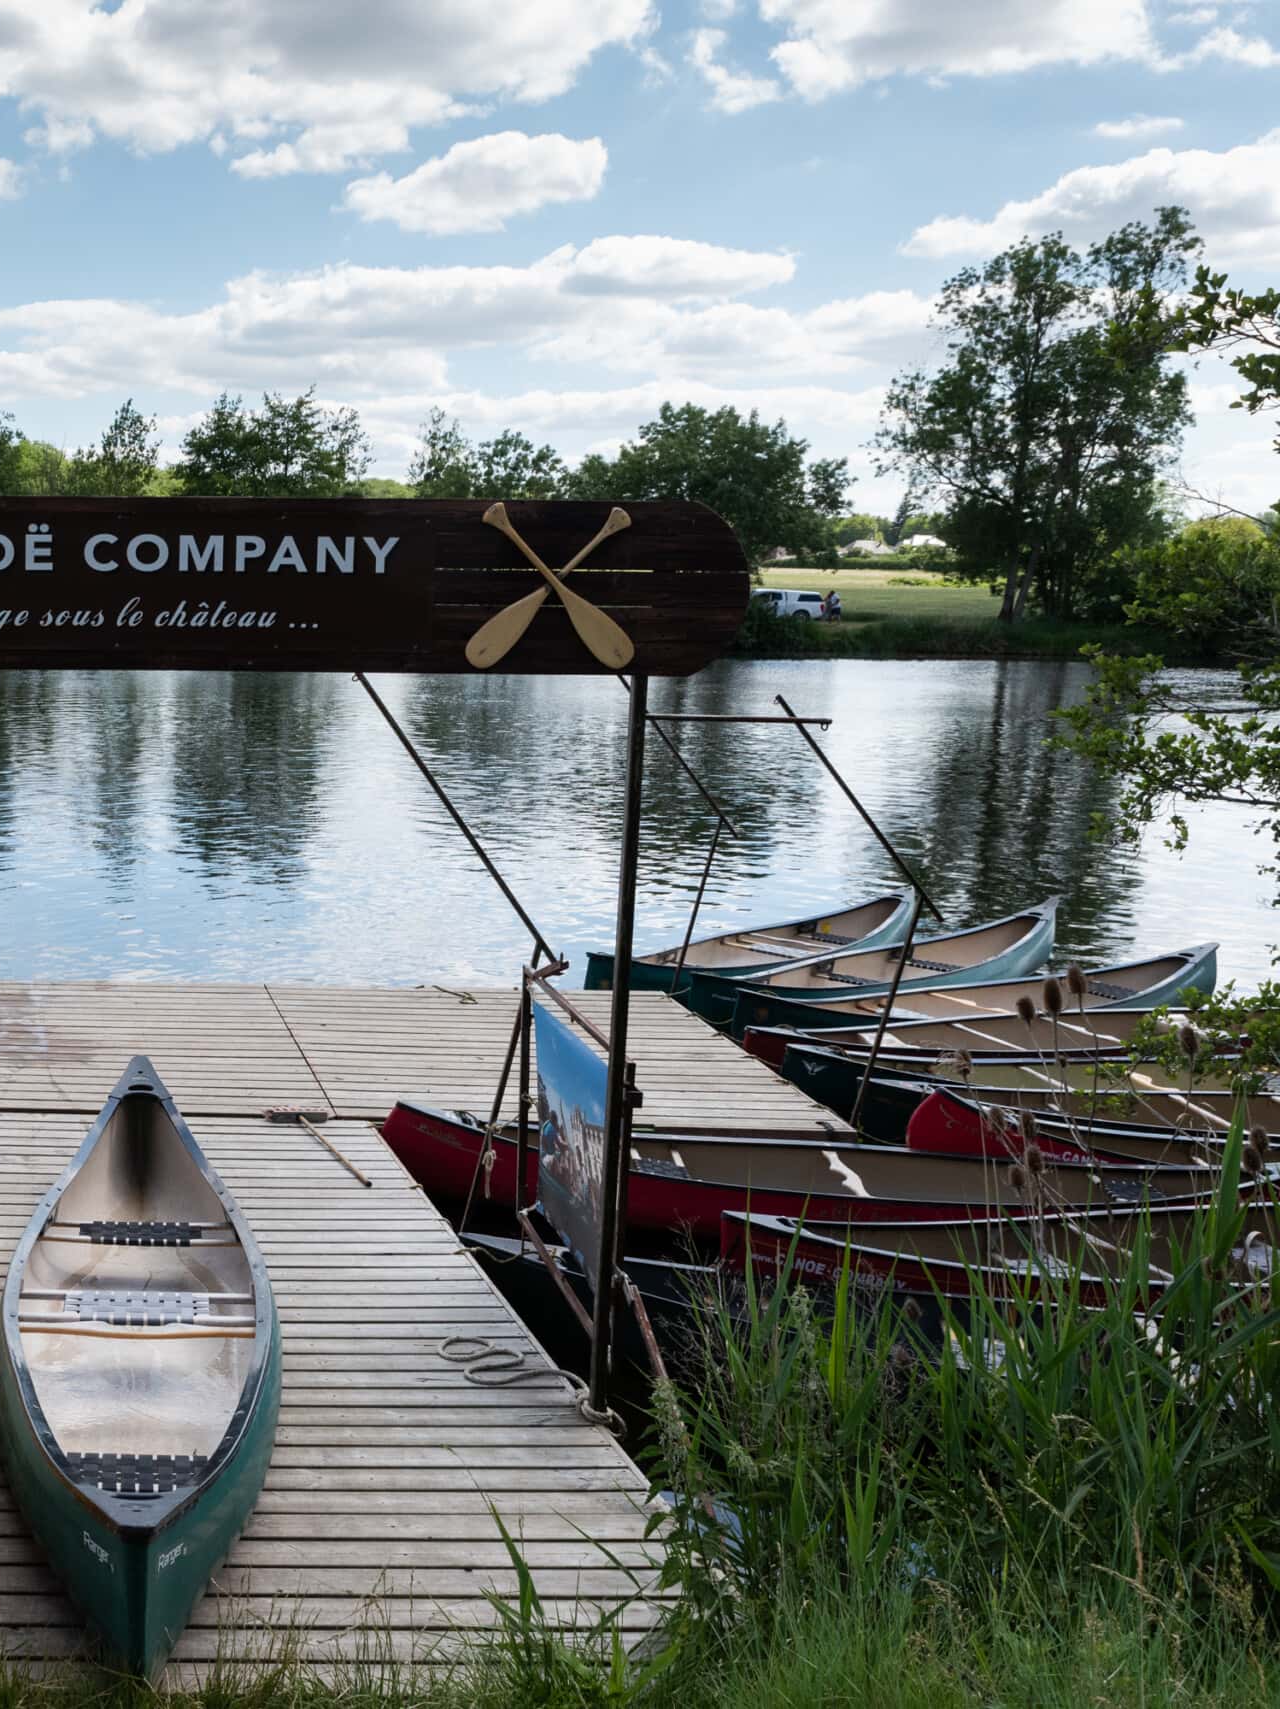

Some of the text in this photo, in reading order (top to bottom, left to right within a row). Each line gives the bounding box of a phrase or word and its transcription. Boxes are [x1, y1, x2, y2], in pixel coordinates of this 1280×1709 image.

[84, 533, 400, 574] COMPANY
[39, 610, 105, 628] sous
[116, 596, 144, 628] le
[154, 599, 278, 629] château
[82, 1531, 110, 1563] Ranger
[158, 1542, 185, 1571] Ranger
